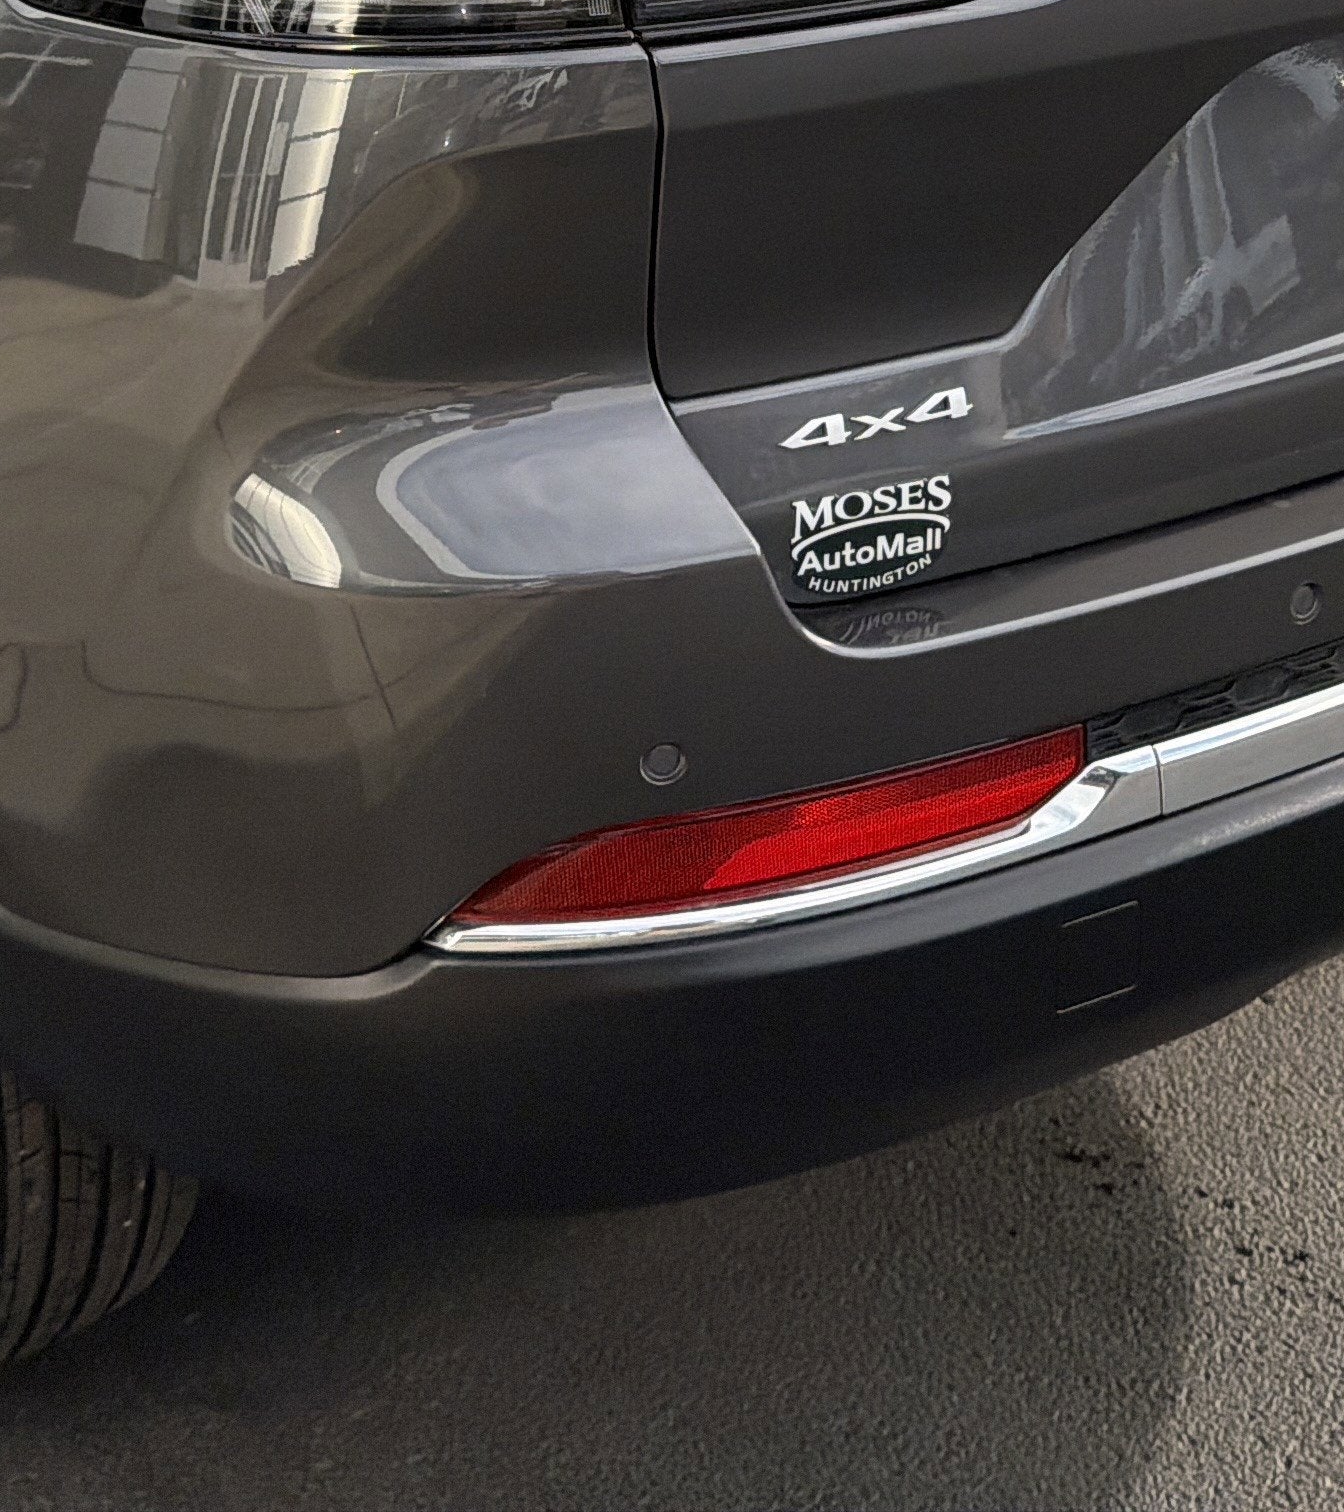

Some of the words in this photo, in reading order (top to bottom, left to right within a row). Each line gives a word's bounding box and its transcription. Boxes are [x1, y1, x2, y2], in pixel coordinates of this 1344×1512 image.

[777, 386, 974, 449] 4x4
[790, 474, 952, 544] MOSES
[796, 527, 942, 576] AutoMall
[808, 554, 932, 594] HUNTINGTON
